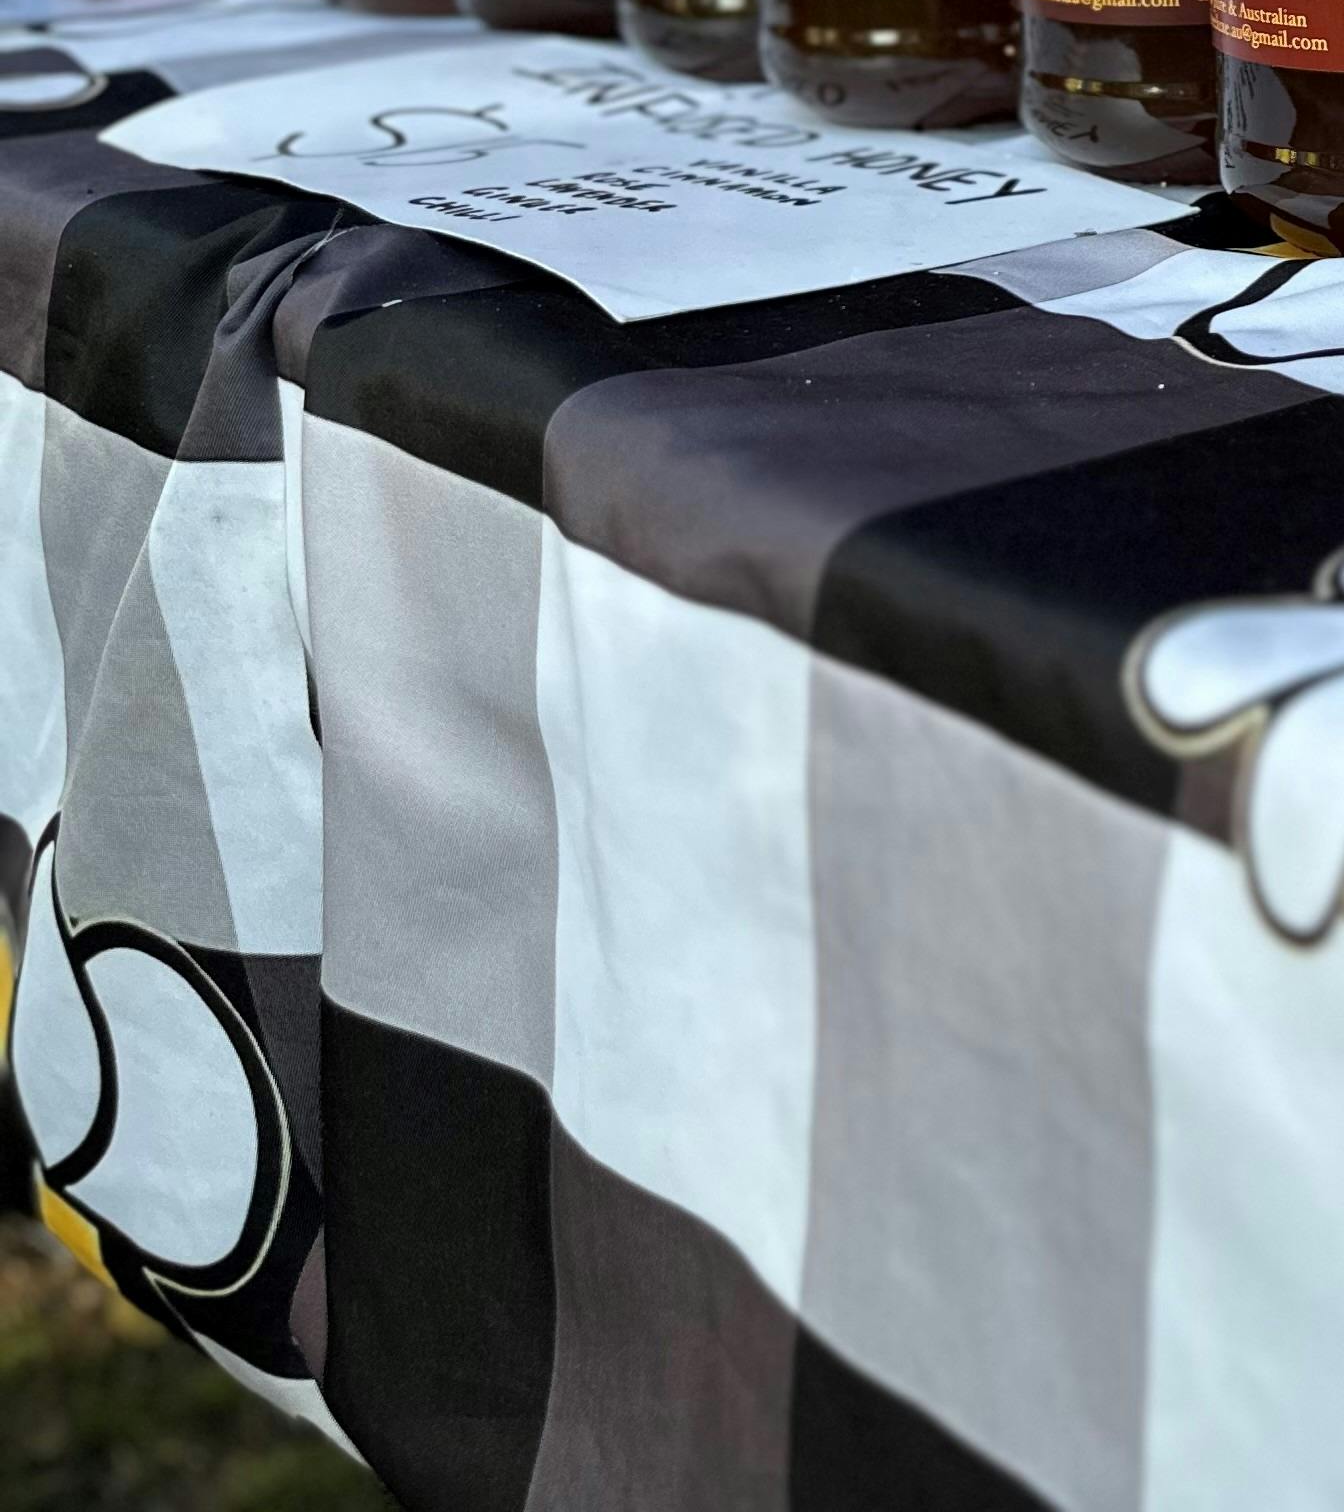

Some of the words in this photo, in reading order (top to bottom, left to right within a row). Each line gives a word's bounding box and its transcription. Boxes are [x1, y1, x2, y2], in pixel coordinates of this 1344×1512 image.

[1228, 0, 1237, 17] &
[1240, 1, 1308, 28] Australian
[574, 170, 672, 190] ROSE
[633, 165, 822, 206] CINNAMON
[690, 158, 847, 194] VANILLA
[807, 146, 1048, 206] HONEY
[409, 196, 522, 222] CHILLI
[462, 187, 599, 215] GINGER
[526, 178, 677, 213] LAVENDER
